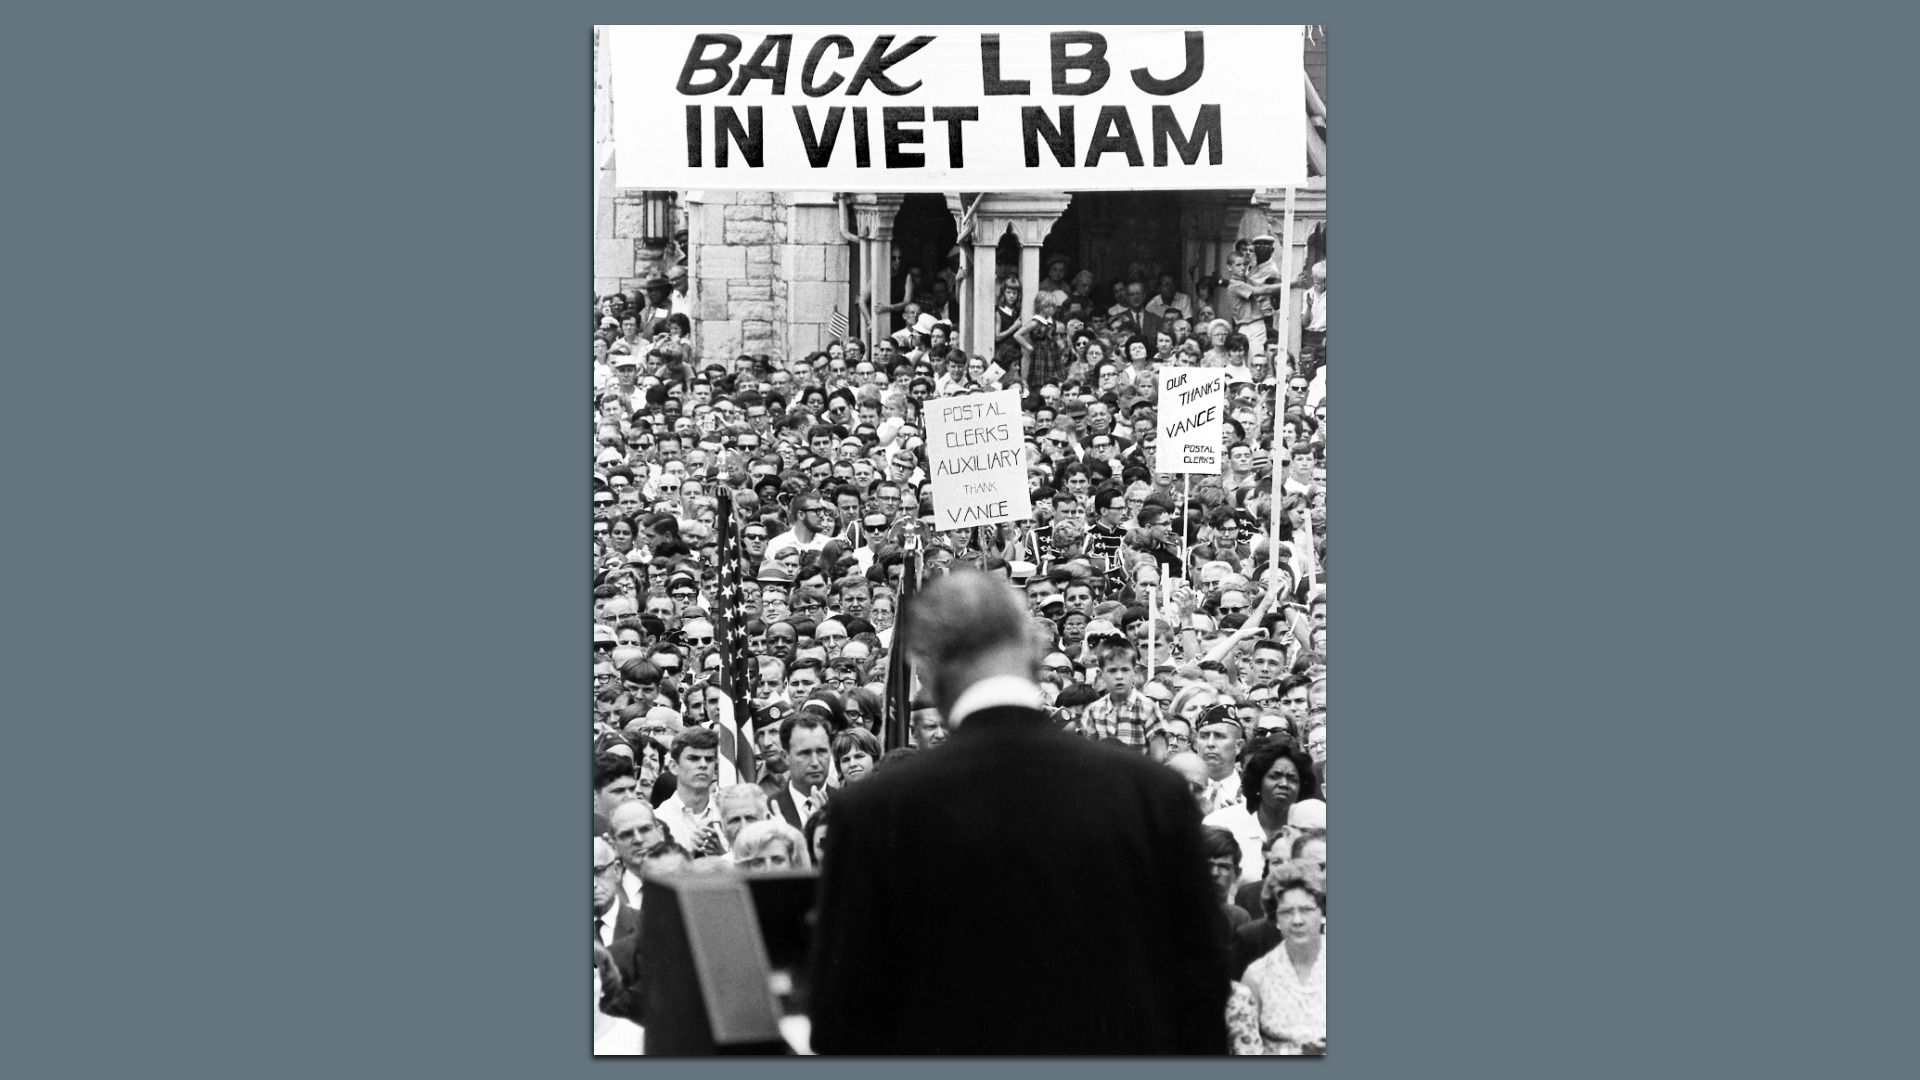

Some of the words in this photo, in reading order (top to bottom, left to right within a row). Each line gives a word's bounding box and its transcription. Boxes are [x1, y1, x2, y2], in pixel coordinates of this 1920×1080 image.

[677, 34, 937, 97] BACK
[981, 31, 1205, 95] LBJ
[686, 105, 764, 168] IN
[792, 105, 978, 168] VIET
[1021, 104, 1222, 167] NAM
[1166, 373, 1187, 391] OUR
[1178, 378, 1220, 407] THANKS
[943, 401, 1007, 423] POSTAL
[1166, 405, 1217, 438] VANCE
[945, 424, 1009, 448] CLERKS
[1183, 444, 1215, 453] POSTAL
[937, 448, 1021, 476] AUXILIARY
[1183, 456, 1215, 465] CLERKS
[963, 481, 998, 495] THANK
[947, 500, 1009, 523] VANCE
